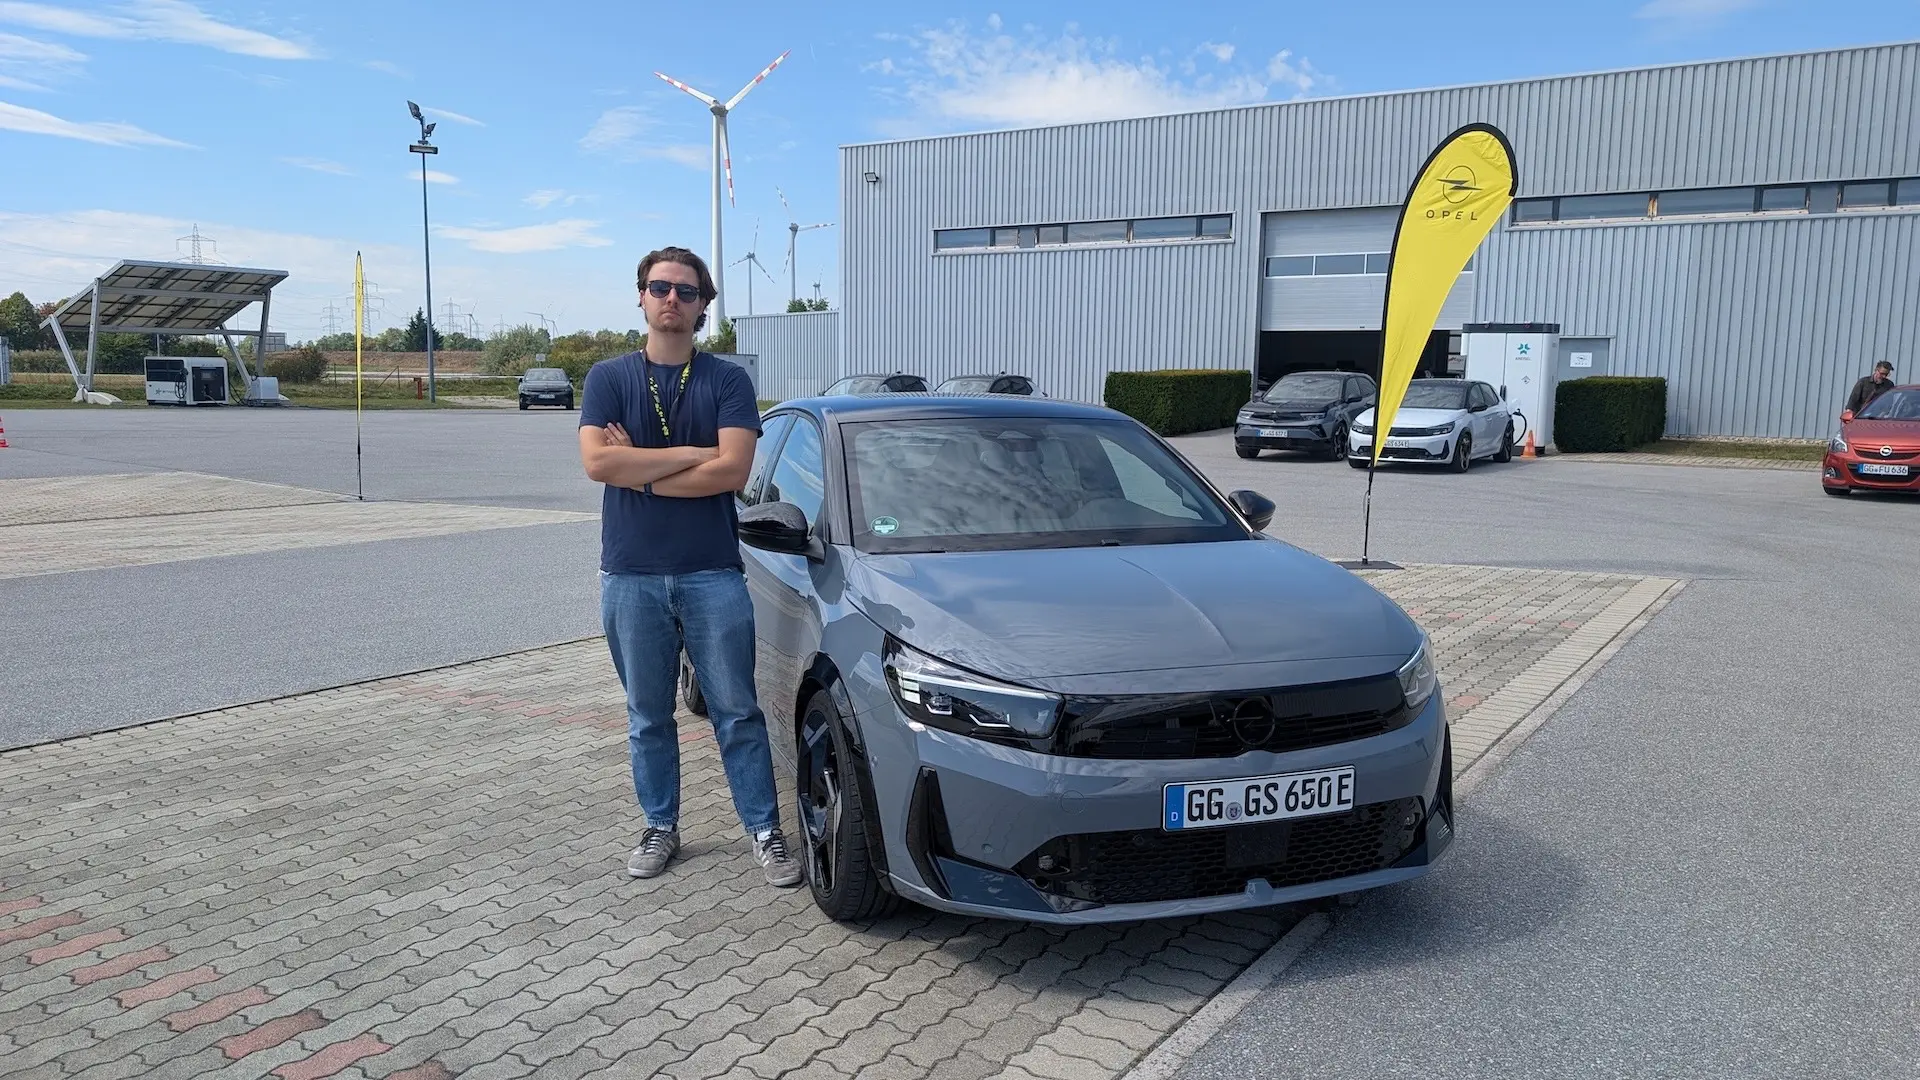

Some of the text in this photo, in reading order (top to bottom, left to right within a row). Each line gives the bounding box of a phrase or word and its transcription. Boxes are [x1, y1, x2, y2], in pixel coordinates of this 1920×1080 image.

[1426, 209, 1478, 221] OPEL
[1878, 465, 1890, 473] FU
[1891, 466, 1907, 474] 636
[1171, 811, 1179, 822] D
[1187, 788, 1224, 822] GG
[1244, 782, 1279, 816] GS
